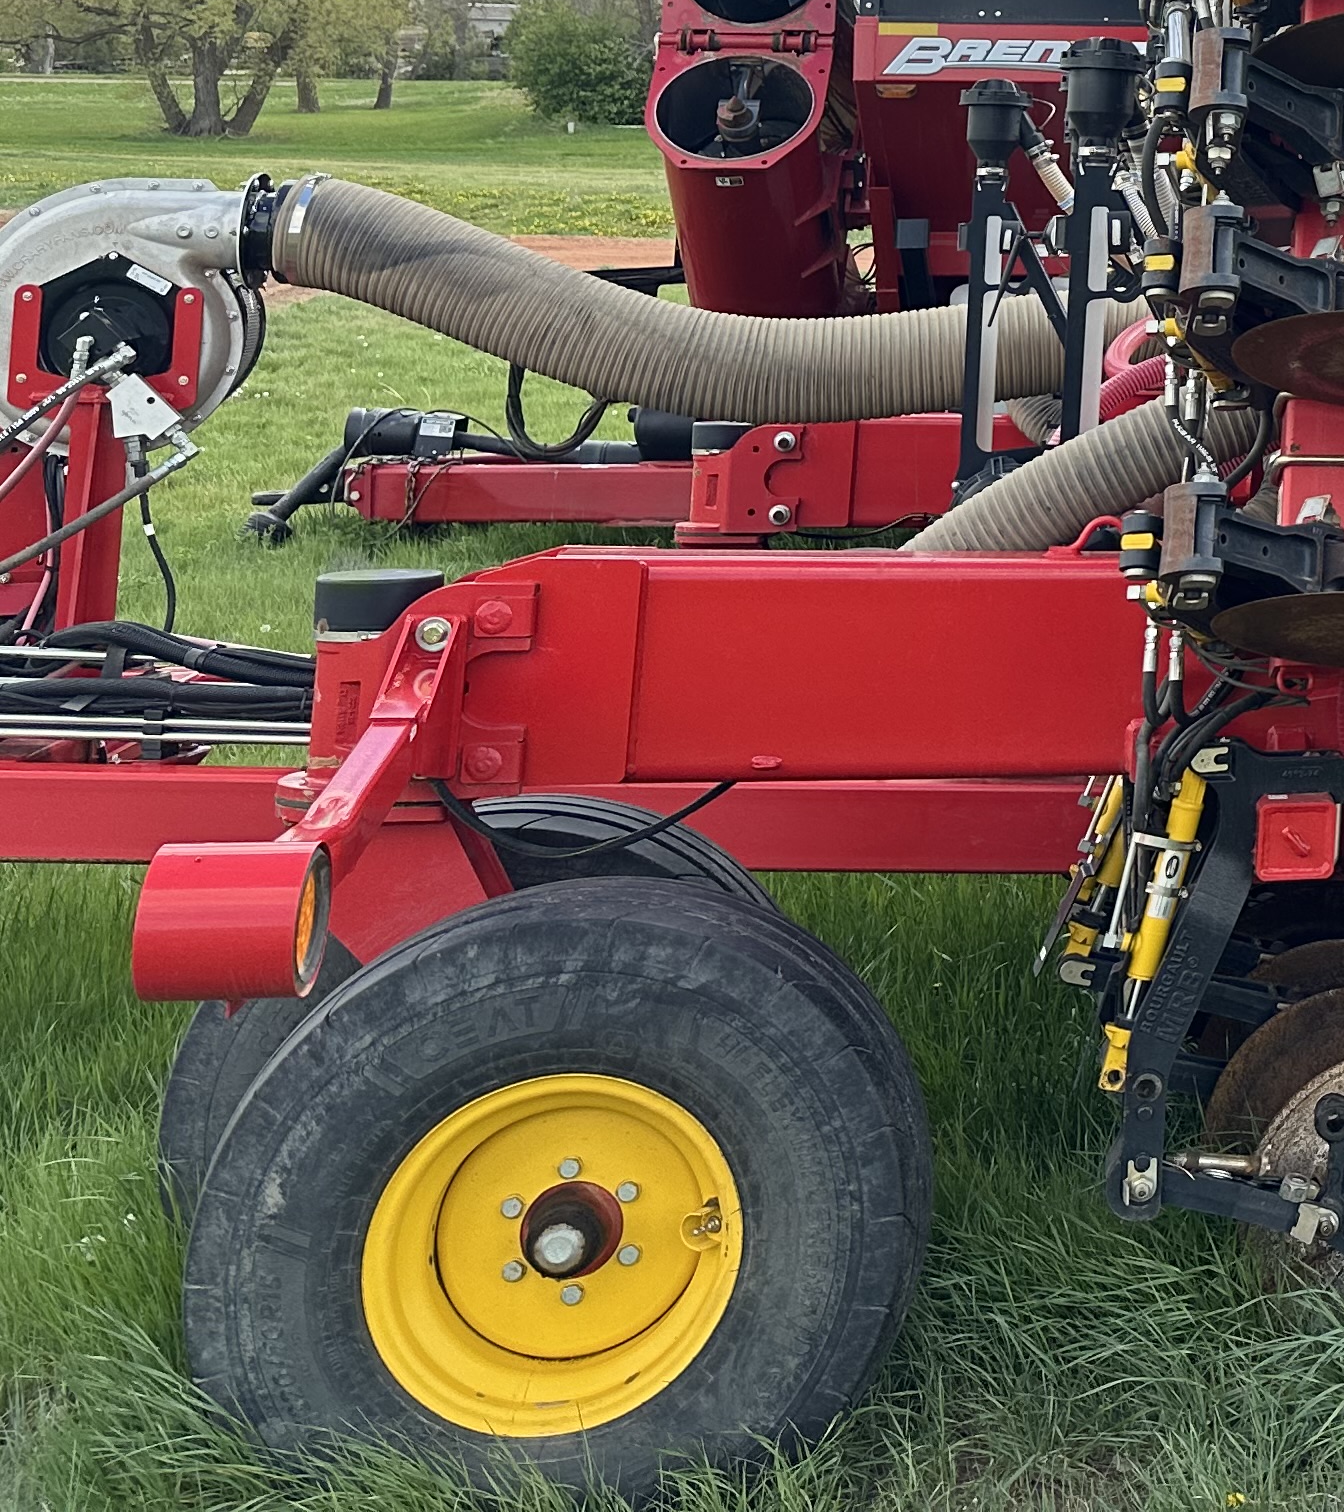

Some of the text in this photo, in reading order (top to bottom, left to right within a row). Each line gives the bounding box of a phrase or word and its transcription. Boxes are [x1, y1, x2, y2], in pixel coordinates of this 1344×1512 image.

[882, 36, 1072, 76] BREN
[1140, 929, 1194, 1034] BOURGAULT
[416, 993, 540, 1062] CEAT
